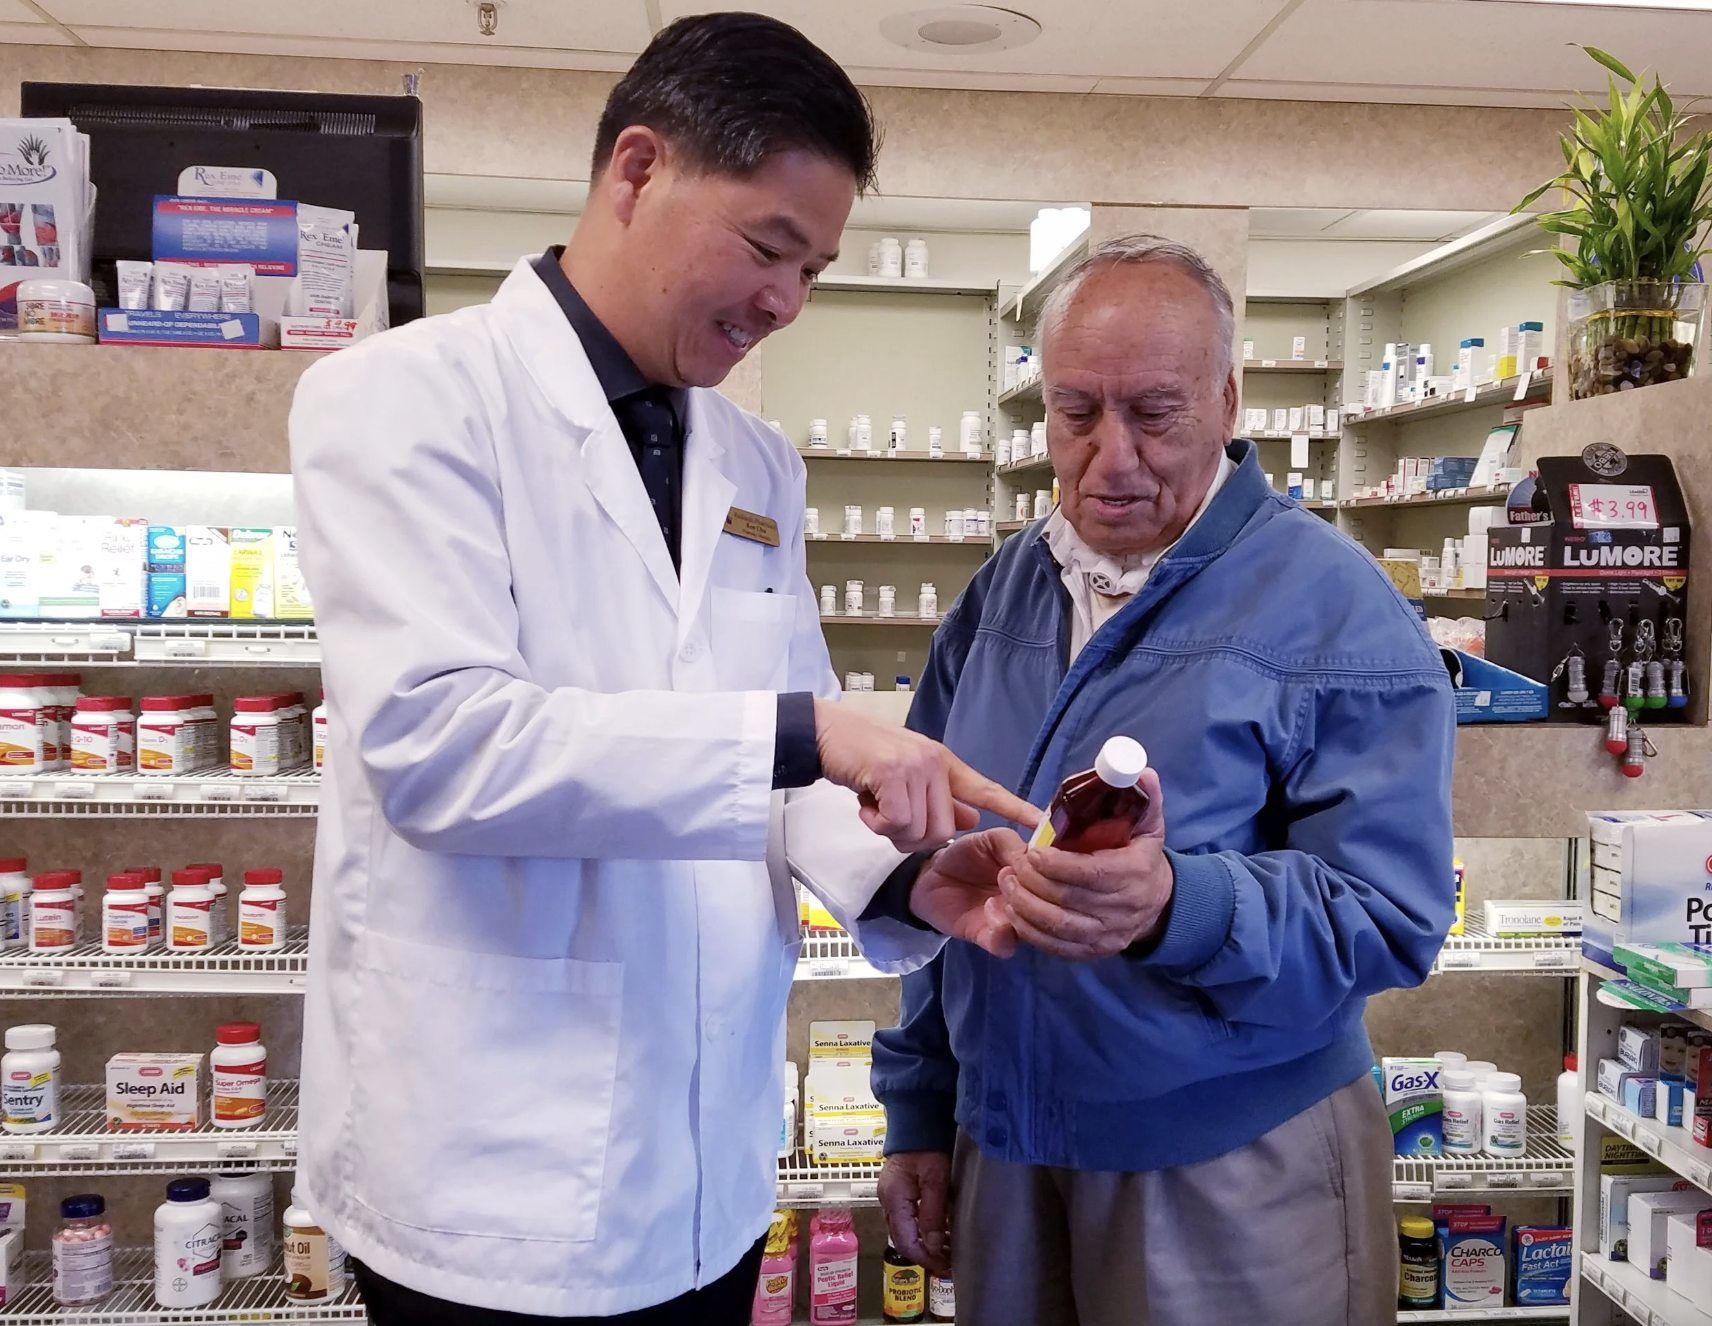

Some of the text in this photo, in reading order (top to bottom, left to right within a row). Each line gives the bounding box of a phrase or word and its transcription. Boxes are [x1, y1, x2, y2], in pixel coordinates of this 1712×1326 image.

[7, 164, 47, 177] More!
[194, 167, 214, 187] Rex
[300, 231, 343, 244] Rex Eme
[125, 310, 232, 320] TRAVELS EVERYWHERE
[1509, 510, 1549, 521] Father's
[102, 542, 135, 554] Relief
[1, 555, 30, 564] Ear Dry
[1686, 897, 1712, 923] Po
[1498, 914, 1542, 924] Tronolane
[1688, 923, 1712, 944] Ti
[840, 1039, 871, 1047] Laxative
[215, 1077, 261, 1087] Super Omega
[1391, 1071, 1440, 1092] Gas-X
[116, 1082, 185, 1098] Sleep Aid
[3, 1093, 44, 1108] Sentry
[845, 1102, 880, 1110] Laxative
[1402, 1104, 1425, 1119] EXTRA
[818, 1137, 884, 1147] Senna Laxative
[297, 1241, 311, 1255] Oil
[1450, 1246, 1503, 1258] CHARCO
[1521, 1241, 1573, 1262] Lactai
[1451, 1258, 1485, 1268] CAPS
[1521, 1259, 1560, 1272] Fast Act
[817, 1270, 854, 1283] Peptic Relief
[827, 1279, 846, 1288] Liquid
[889, 1286, 922, 1296] PROBIOTIC
[894, 1294, 917, 1302] BLEND
